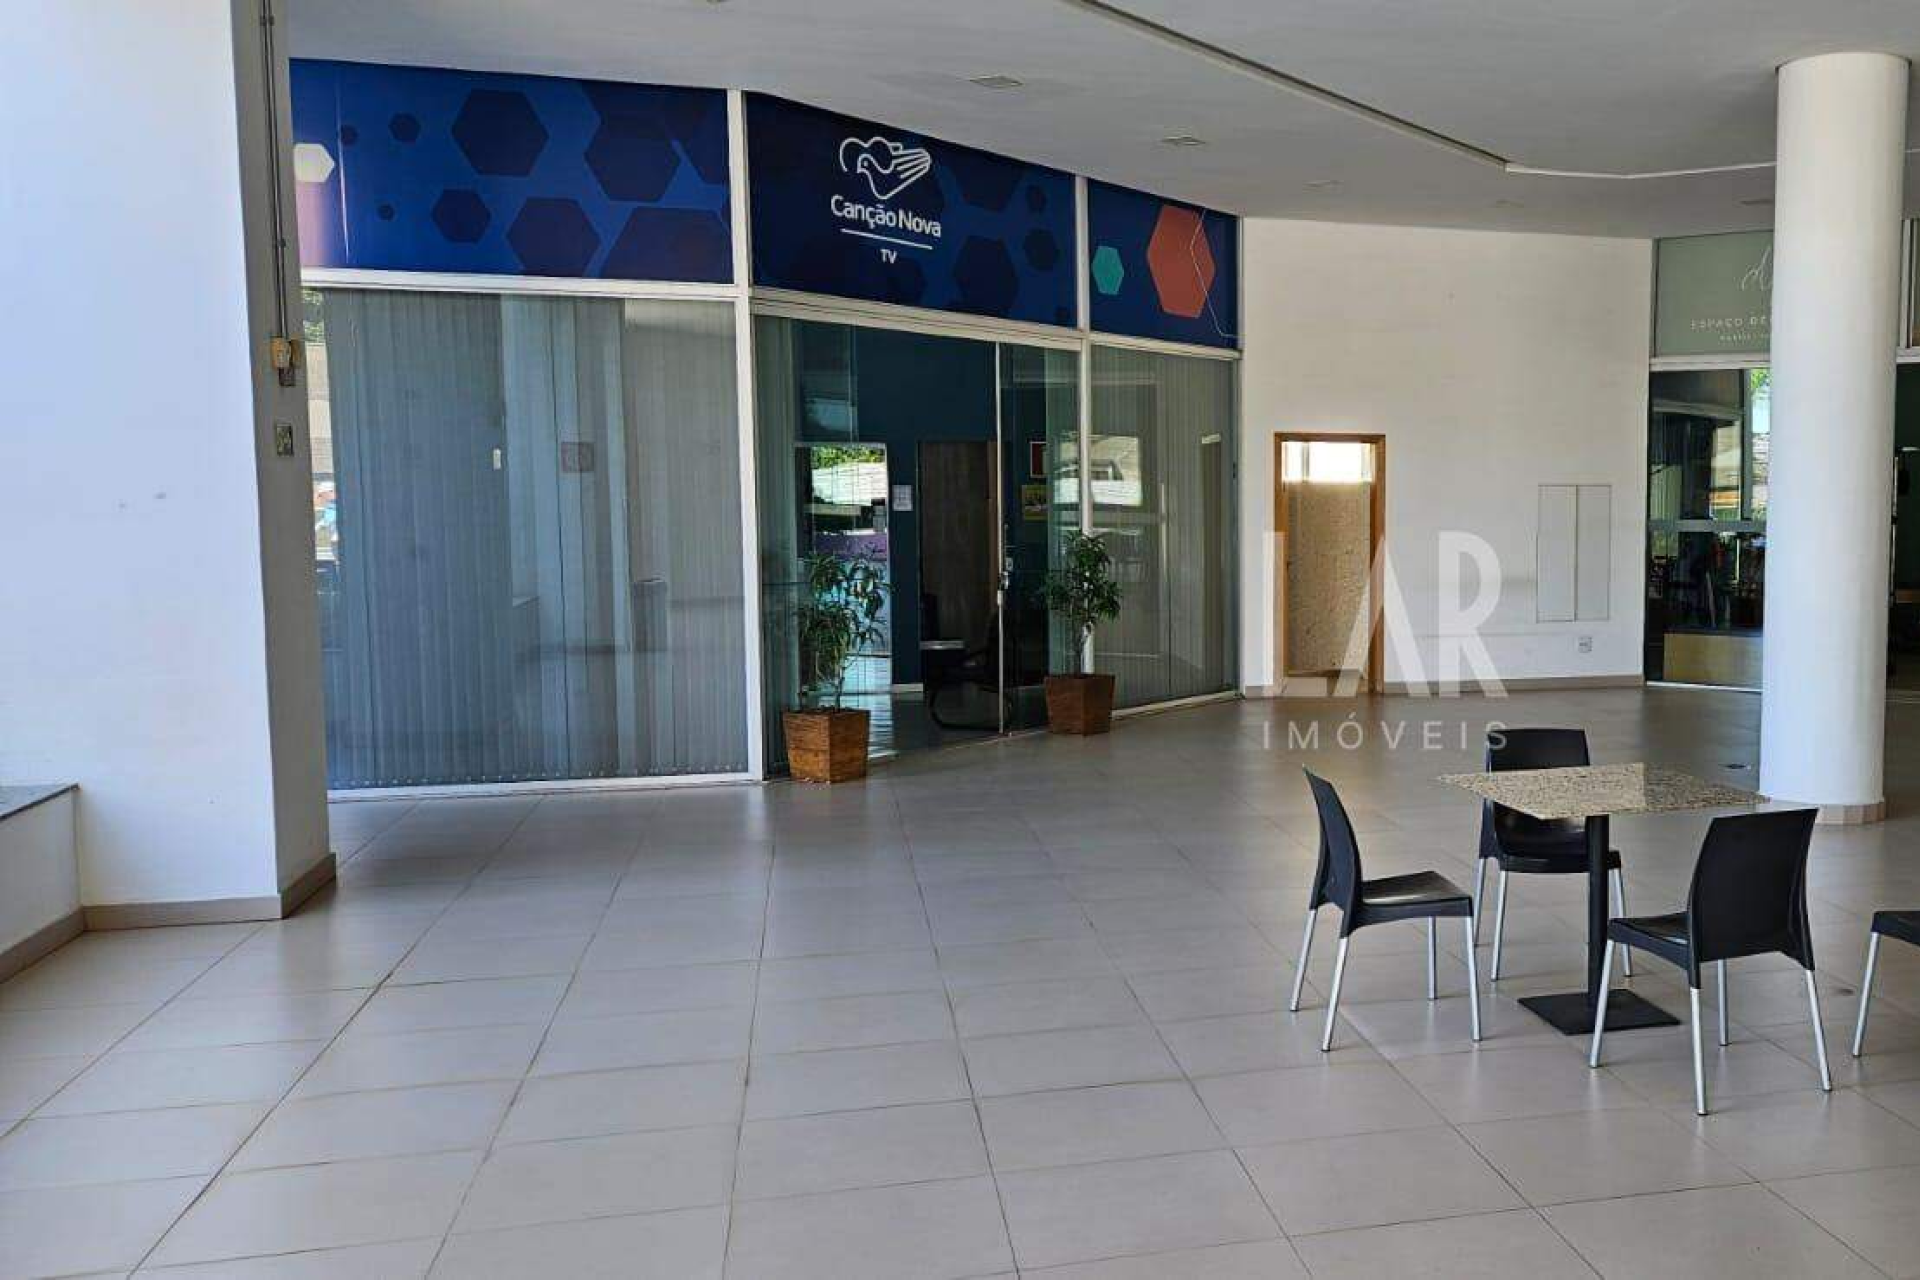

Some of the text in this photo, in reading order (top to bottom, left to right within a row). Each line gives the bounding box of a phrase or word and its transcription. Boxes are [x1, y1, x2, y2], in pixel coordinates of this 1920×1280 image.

[830, 194, 941, 237] Canção Nova
[880, 248, 898, 264] TV
